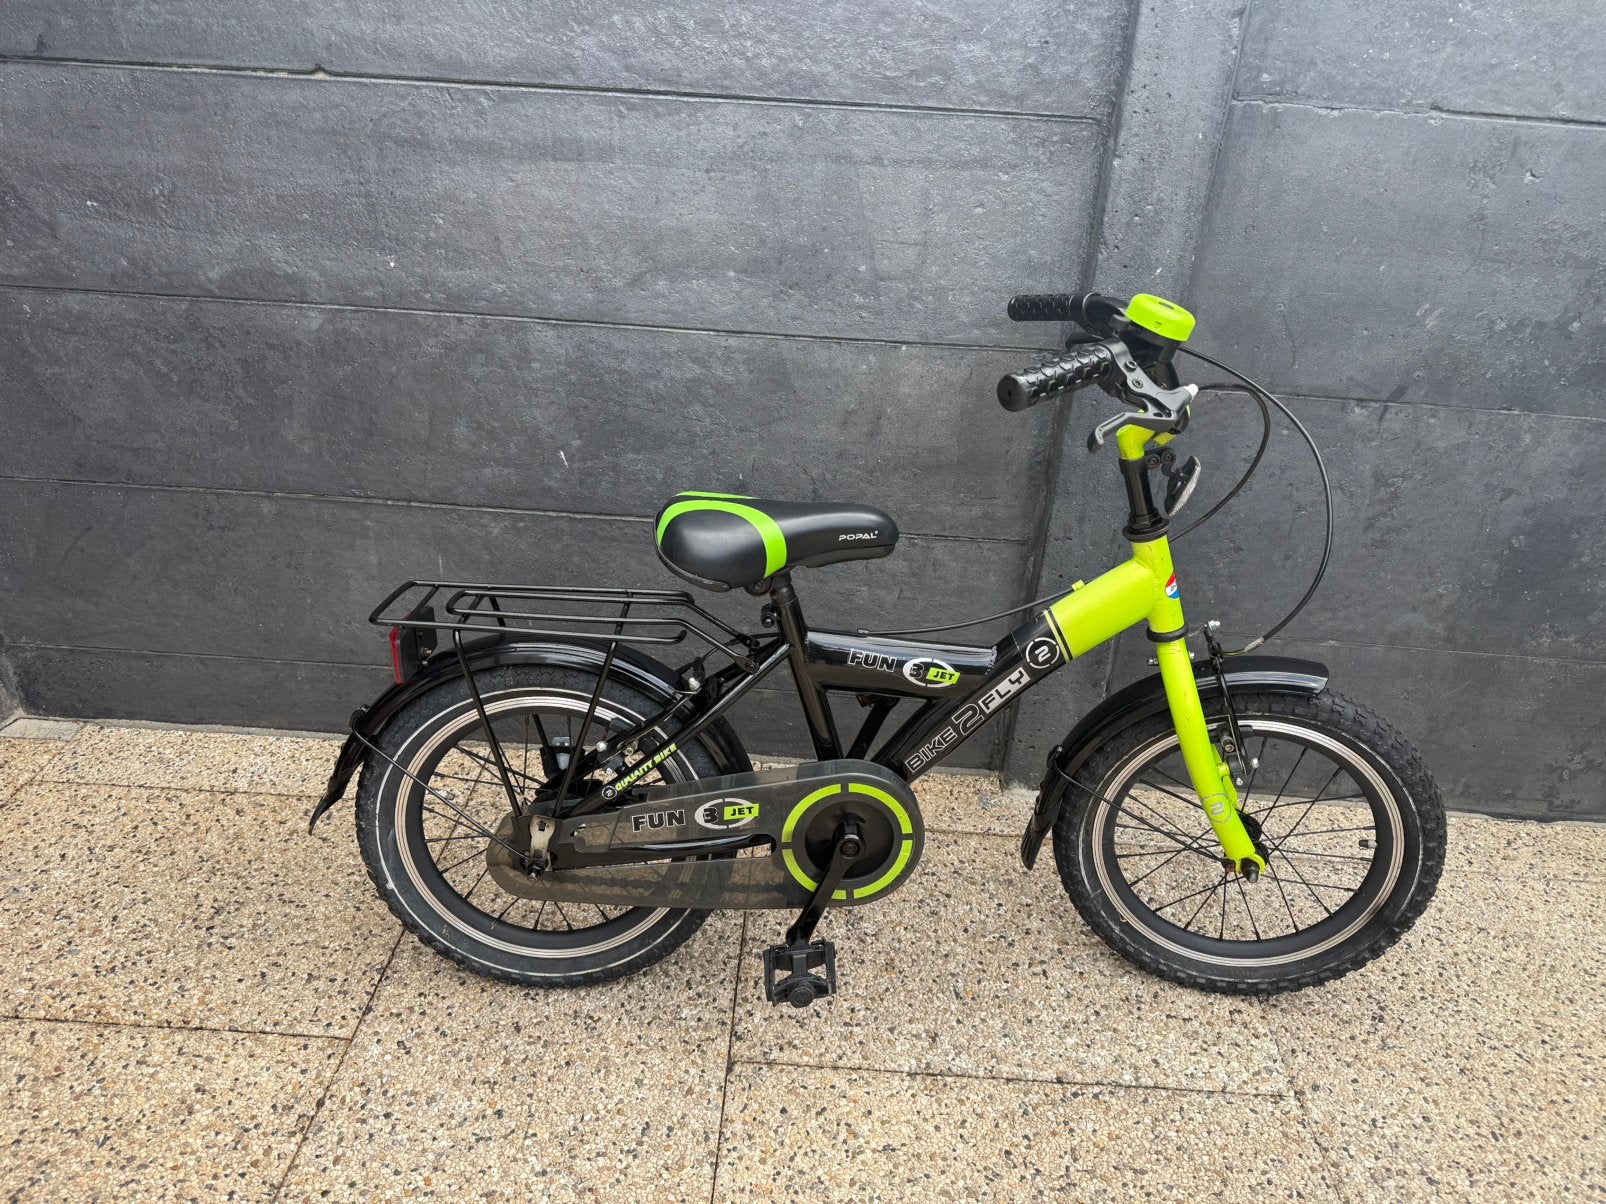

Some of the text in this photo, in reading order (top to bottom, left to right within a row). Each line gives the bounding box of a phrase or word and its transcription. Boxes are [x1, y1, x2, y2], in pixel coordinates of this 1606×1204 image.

[838, 532, 877, 541] POPAL
[848, 649, 897, 673] FUN
[933, 670, 955, 682] JET
[904, 726, 958, 773] BIKE
[979, 669, 1028, 712] FLY
[631, 809, 686, 833] FUN
[730, 806, 754, 817] JET
